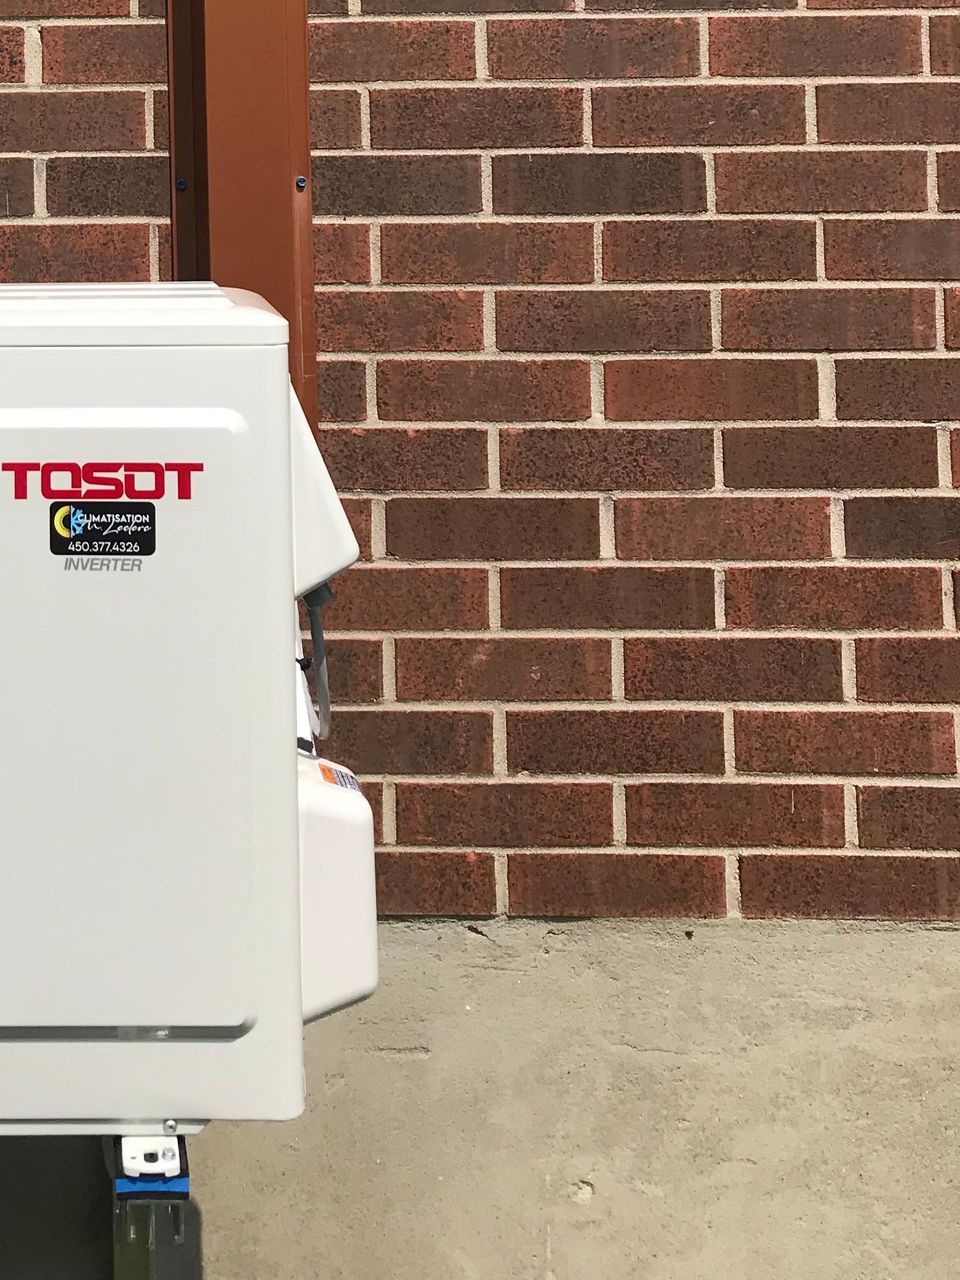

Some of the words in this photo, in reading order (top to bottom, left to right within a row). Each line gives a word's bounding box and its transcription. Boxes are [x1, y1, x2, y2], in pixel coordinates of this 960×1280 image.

[1, 462, 204, 500] TOSOT
[77, 513, 150, 523] CLIMATISATION
[67, 541, 140, 553] 450.377.4326
[64, 557, 143, 572] INVERTER
